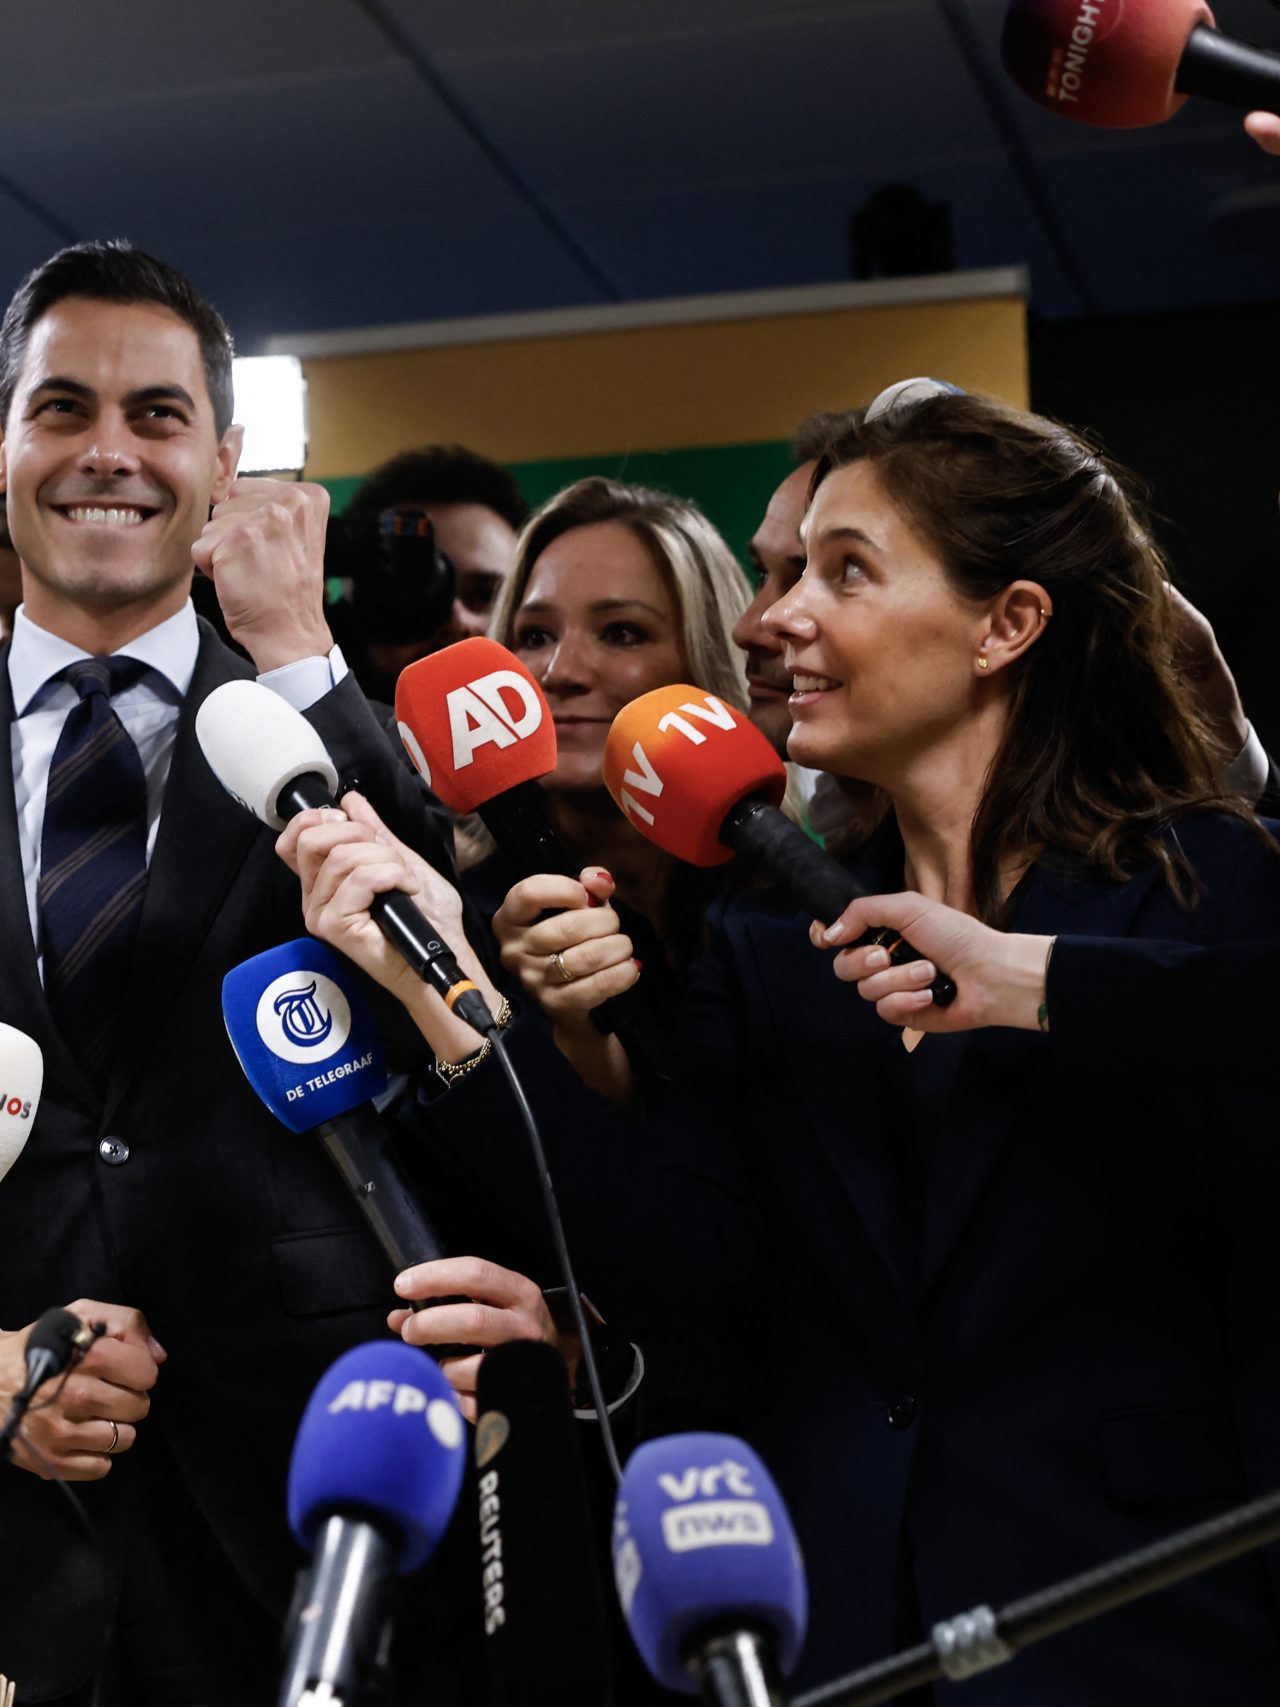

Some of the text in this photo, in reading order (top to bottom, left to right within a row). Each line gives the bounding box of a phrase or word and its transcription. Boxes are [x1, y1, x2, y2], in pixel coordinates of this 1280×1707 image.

[1058, 0, 1103, 101] TONIGH
[446, 670, 542, 771] AD
[285, 1052, 373, 1102] DE TELEGRAAF
[328, 1380, 428, 1415] AFP
[657, 1459, 756, 1501] vrt
[676, 1512, 760, 1538] nws
[478, 1470, 505, 1635] REUTERS
